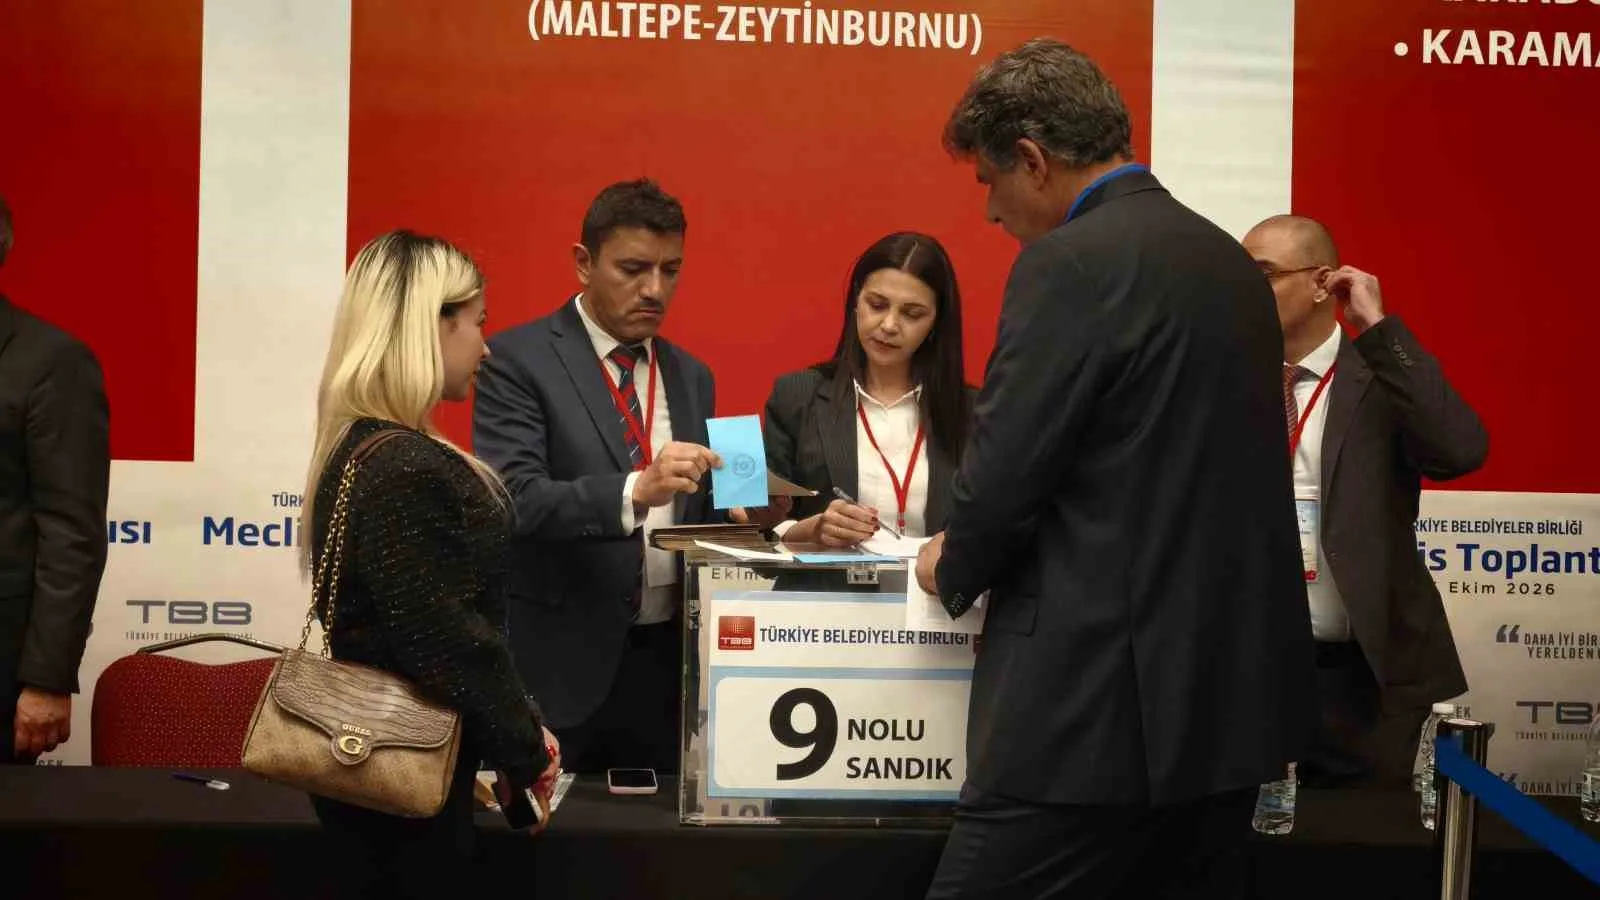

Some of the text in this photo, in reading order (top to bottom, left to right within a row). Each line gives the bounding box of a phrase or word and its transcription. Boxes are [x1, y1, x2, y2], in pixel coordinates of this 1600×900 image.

[528, 0, 983, 55] (MALTEPE-ZEYTİNBURNU)
[1451, 518, 1534, 534] BELEDİYELER
[1537, 519, 1582, 535] BİRLİĞİ
[1449, 581, 1555, 595] Ekim 2026
[126, 600, 252, 625] TBB
[760, 625, 819, 643] TÜRKİYE
[823, 627, 914, 645] BELEDİYELER
[1524, 633, 1555, 645] DAHA
[1559, 632, 1574, 646] İYİ
[1528, 646, 1594, 660] YERELDEN
[1516, 701, 1600, 725] TB
[769, 687, 838, 781] 9
[847, 719, 925, 741] NOLU
[340, 735, 362, 755] G
[846, 757, 952, 780] SANDIK
